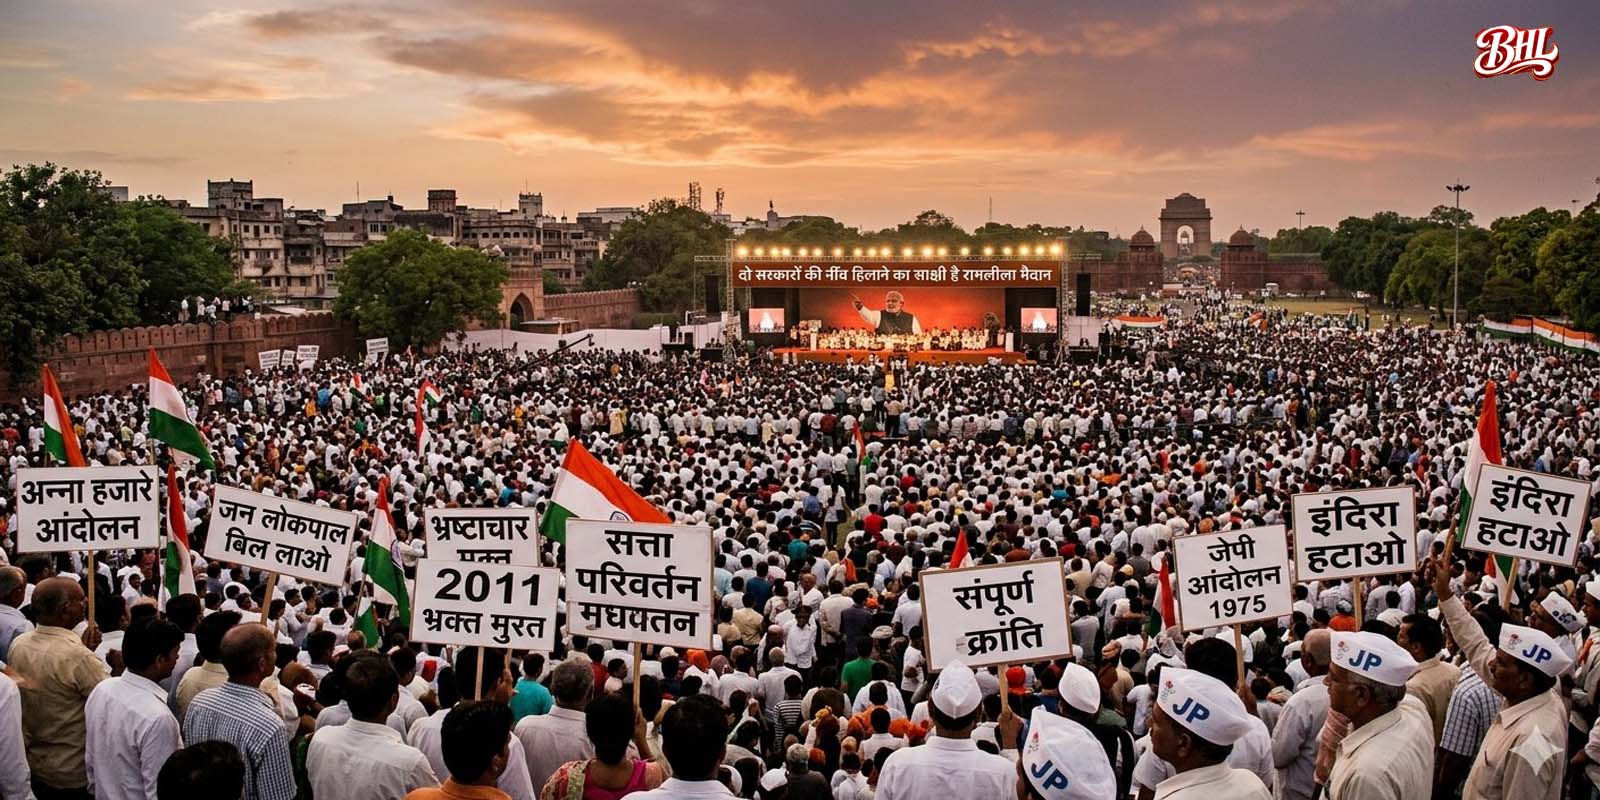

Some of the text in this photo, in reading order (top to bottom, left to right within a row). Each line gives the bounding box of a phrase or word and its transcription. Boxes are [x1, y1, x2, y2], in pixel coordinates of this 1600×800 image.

[738, 265, 753, 282] दो
[755, 265, 802, 282] सरकारों
[804, 265, 823, 282] की
[851, 265, 890, 282] हिलाने
[892, 269, 910, 282] का
[913, 265, 947, 282] साक्षी
[950, 265, 960, 282] है
[962, 265, 1017, 282] रामलीला
[1020, 265, 1052, 282] मैदान
[21, 470, 154, 505] अन्ना हजारे
[1489, 474, 1576, 518] इंदिरा
[35, 508, 141, 543] आंदोलन
[218, 498, 351, 545] जन लोकपाल
[430, 515, 530, 541] भ्रष्टाचार
[1307, 496, 1400, 537] इंदिरा
[224, 526, 333, 573] बिल लाओ
[604, 529, 674, 558] सत्ता
[1206, 534, 1256, 563] जेपी
[1304, 531, 1407, 574] हटाओ
[1476, 516, 1573, 557] हटाओ
[434, 567, 540, 606] 2011
[575, 561, 702, 602] परिवर्तन
[952, 570, 1035, 617] संपूर्ण
[1187, 565, 1282, 597] आंदोलन
[1209, 593, 1267, 619] 1975
[490, 613, 547, 645] मुरत
[964, 616, 1044, 657] क्रांति
[1348, 649, 1382, 671] JP
[1522, 644, 1552, 664] JP
[1172, 697, 1210, 723] JP
[1030, 759, 1069, 791] JP
